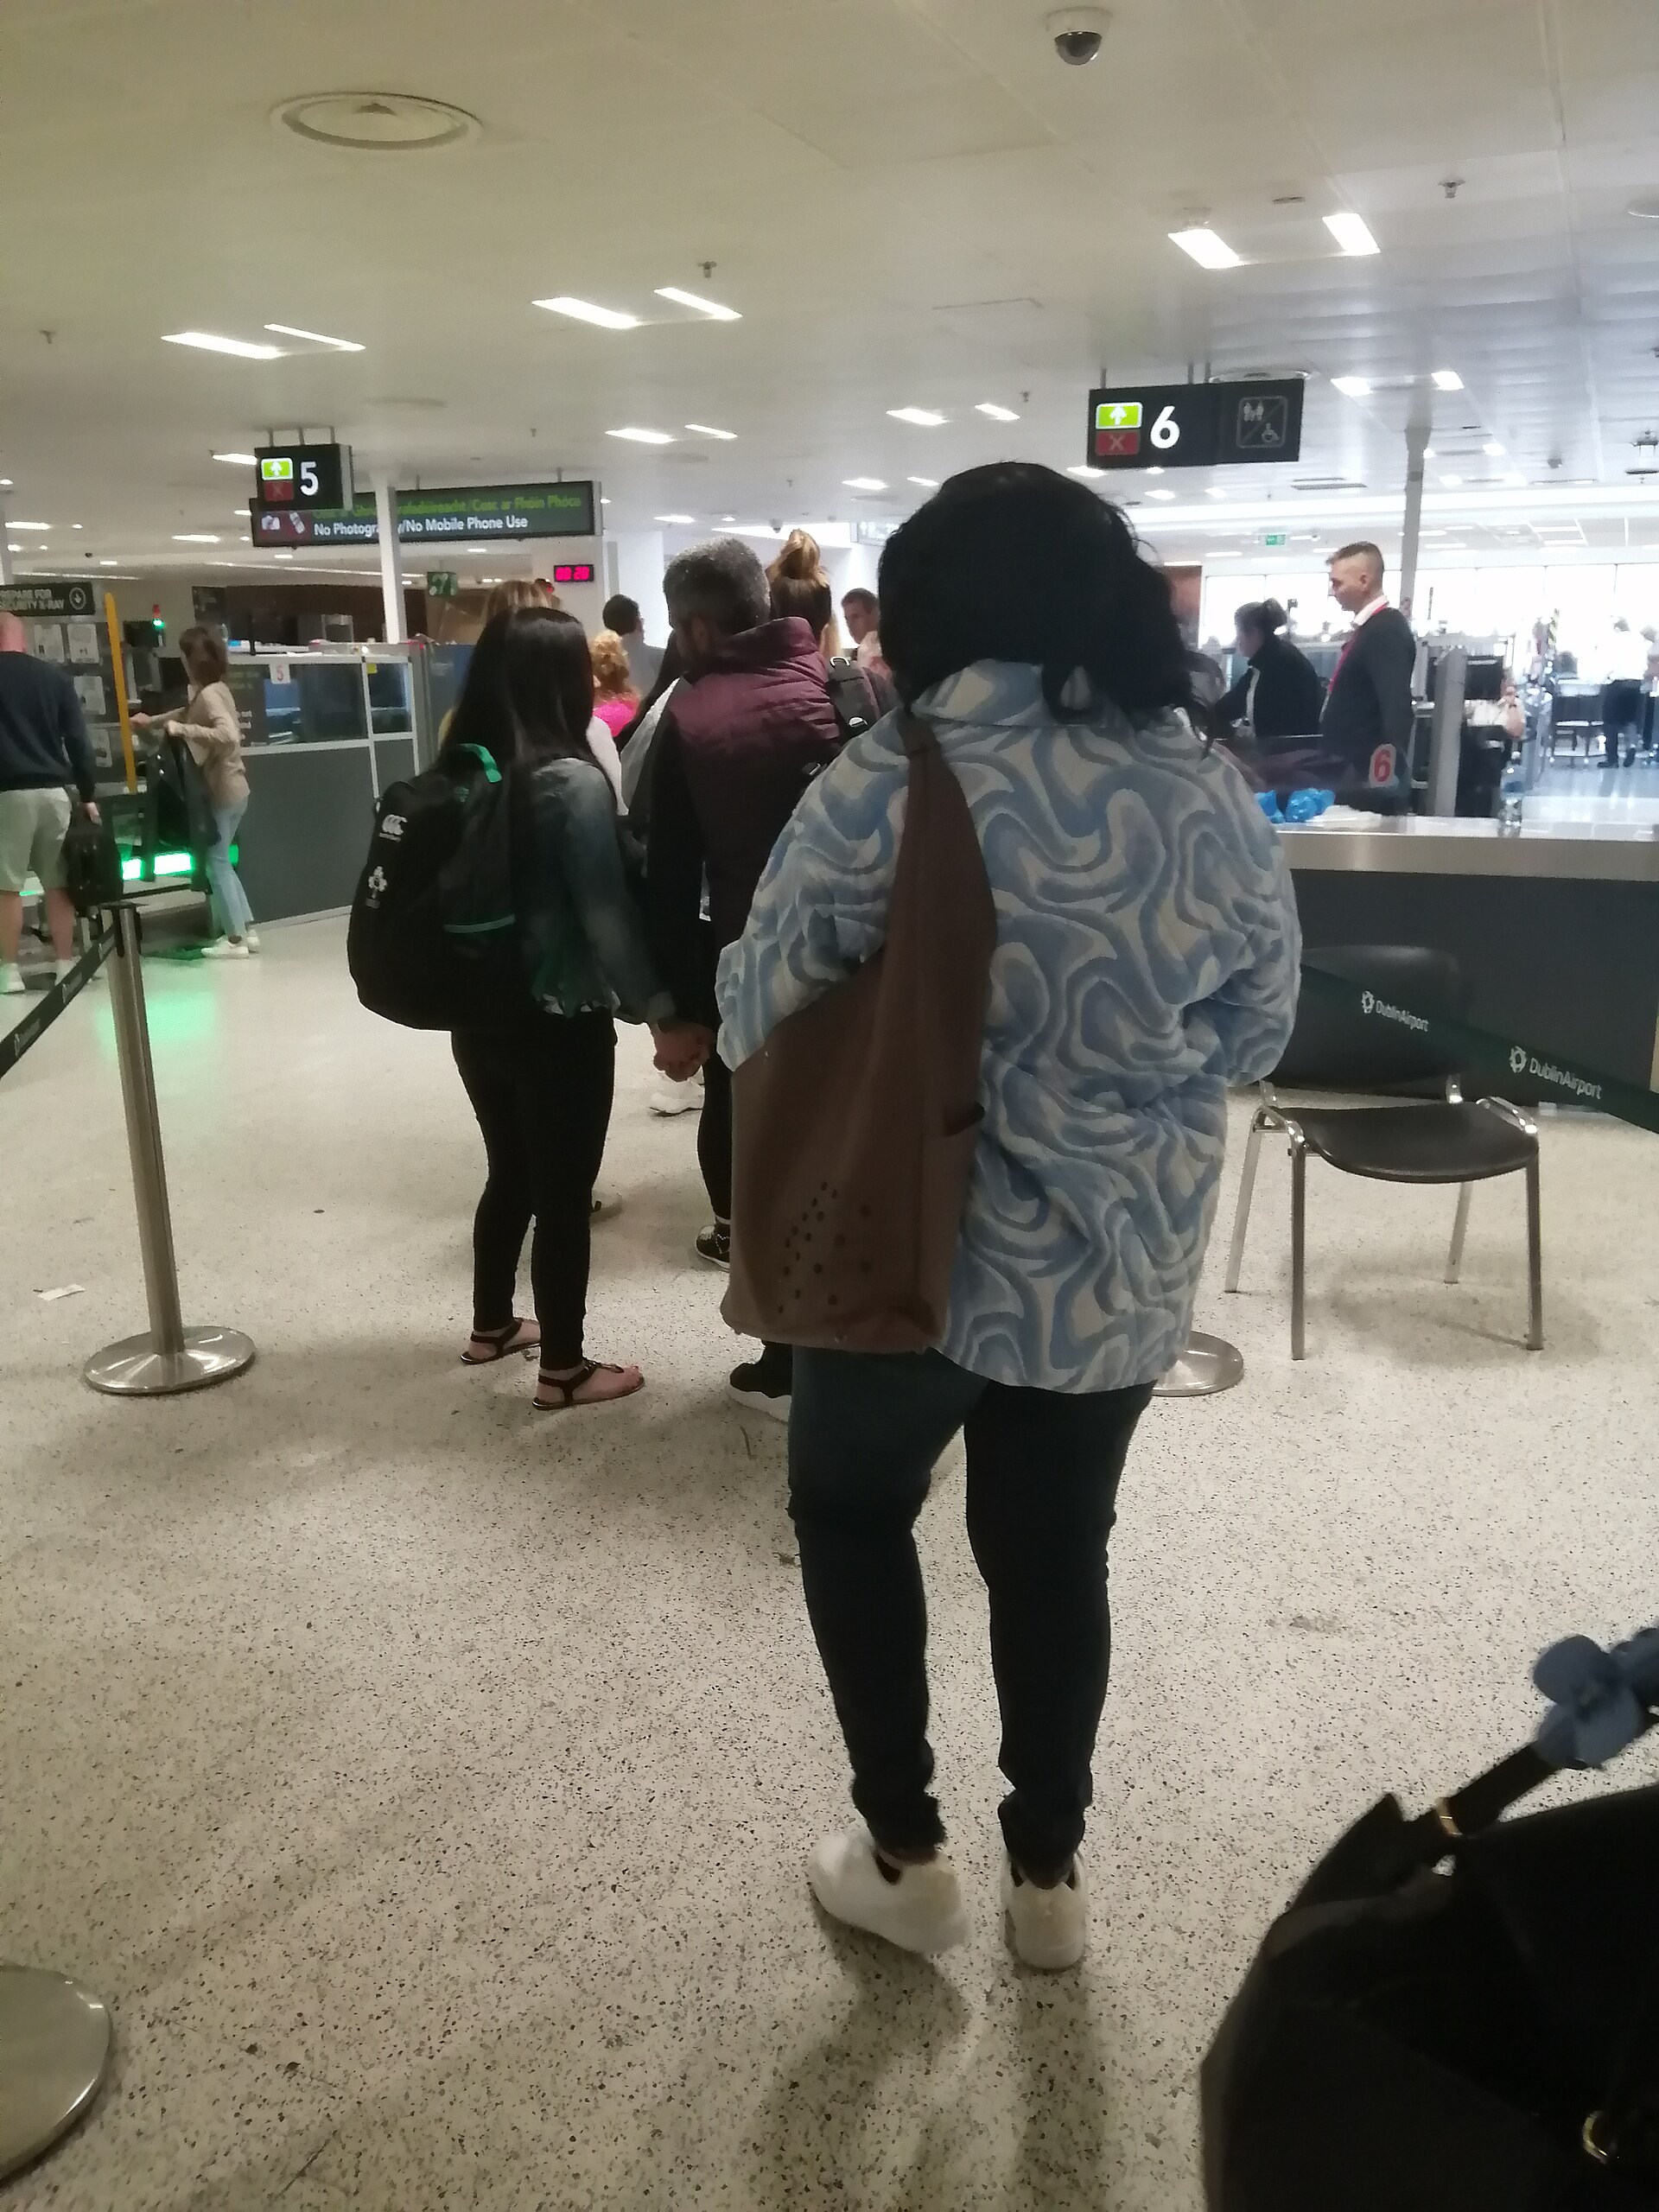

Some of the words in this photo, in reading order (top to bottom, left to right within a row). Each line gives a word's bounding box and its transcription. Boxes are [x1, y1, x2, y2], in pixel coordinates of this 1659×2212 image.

[1150, 405, 1180, 449] 6
[300, 461, 319, 496] 5
[314, 522, 331, 537] No
[425, 517, 464, 533] Mobile
[467, 515, 503, 530] Phone
[505, 514, 529, 529] Use
[1374, 748, 1392, 783] 6
[1529, 1057, 1603, 1100] DublinAirport
